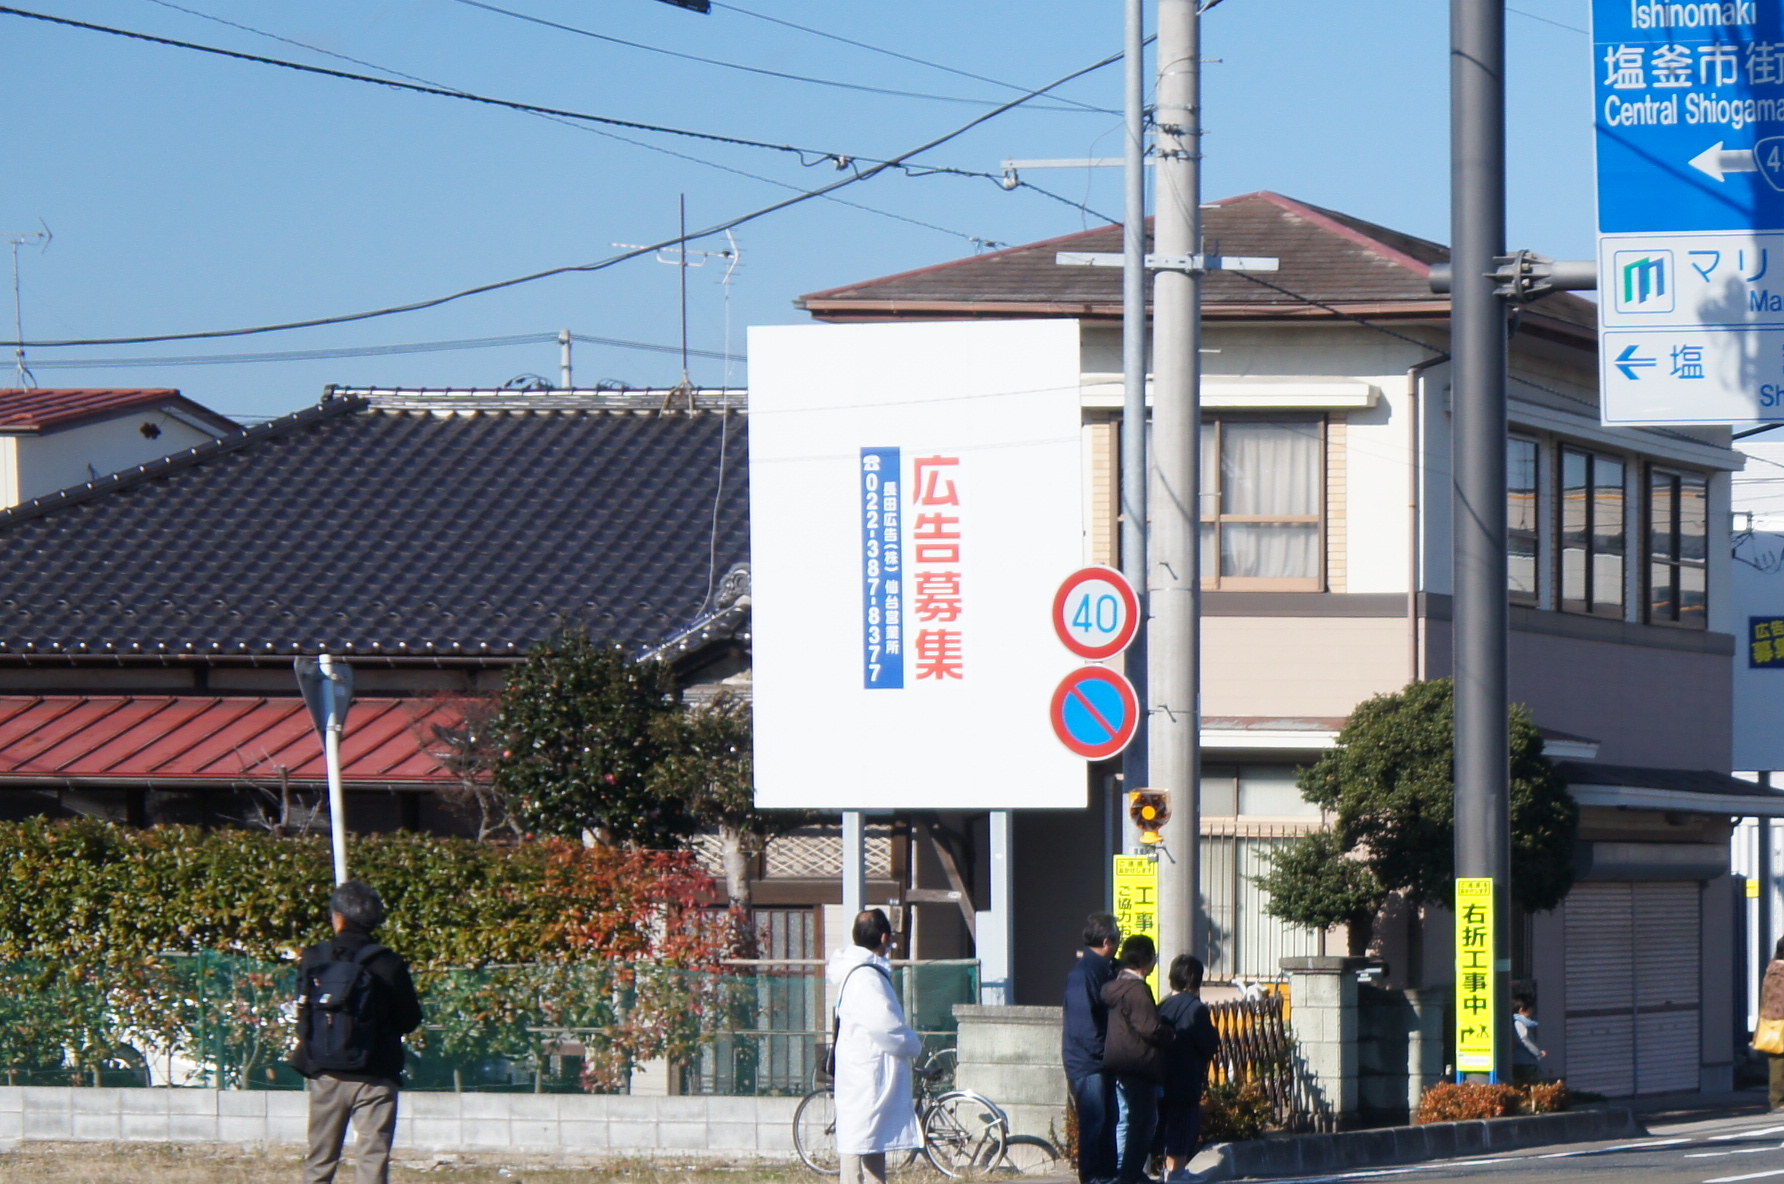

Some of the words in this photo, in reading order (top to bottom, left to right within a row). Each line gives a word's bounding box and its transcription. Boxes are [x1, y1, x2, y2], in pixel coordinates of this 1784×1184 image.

[1631, 0, 1756, 28] Ishinomaki
[1604, 94, 1678, 127] Central
[865, 473, 881, 682] 022-387-8377
[913, 455, 963, 681] 広告募集
[1071, 594, 1119, 634] 40
[1462, 903, 1488, 1016] 右折工事中
